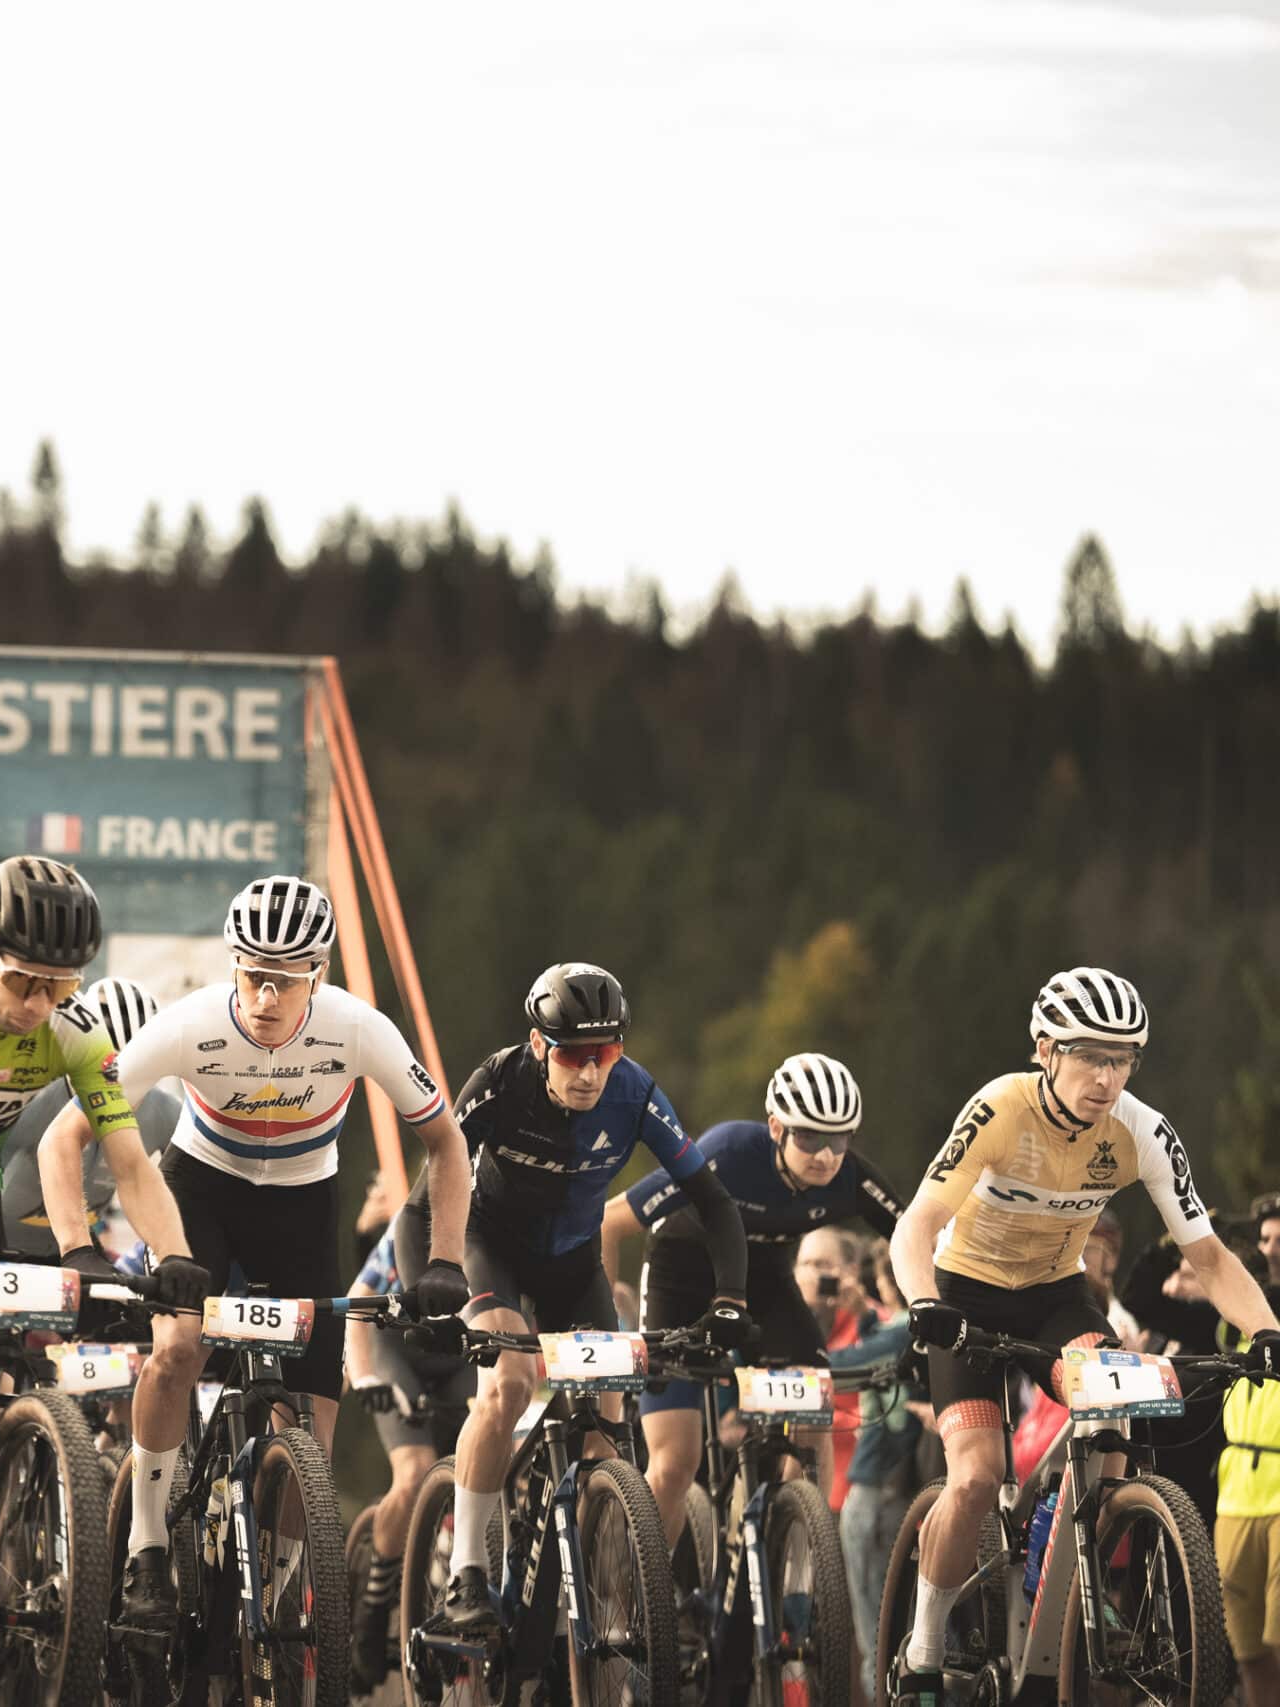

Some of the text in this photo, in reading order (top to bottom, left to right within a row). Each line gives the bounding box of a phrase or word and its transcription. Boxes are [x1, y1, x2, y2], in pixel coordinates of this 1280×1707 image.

[97, 815, 278, 861] FRANCE
[577, 1020, 619, 1029] BULLS
[3, 1272, 19, 1294] 3
[234, 1304, 281, 1328] 185
[581, 1347, 597, 1363] 2
[83, 1362, 96, 1379] 8
[1108, 1371, 1121, 1390] 1
[764, 1382, 805, 1399] 119
